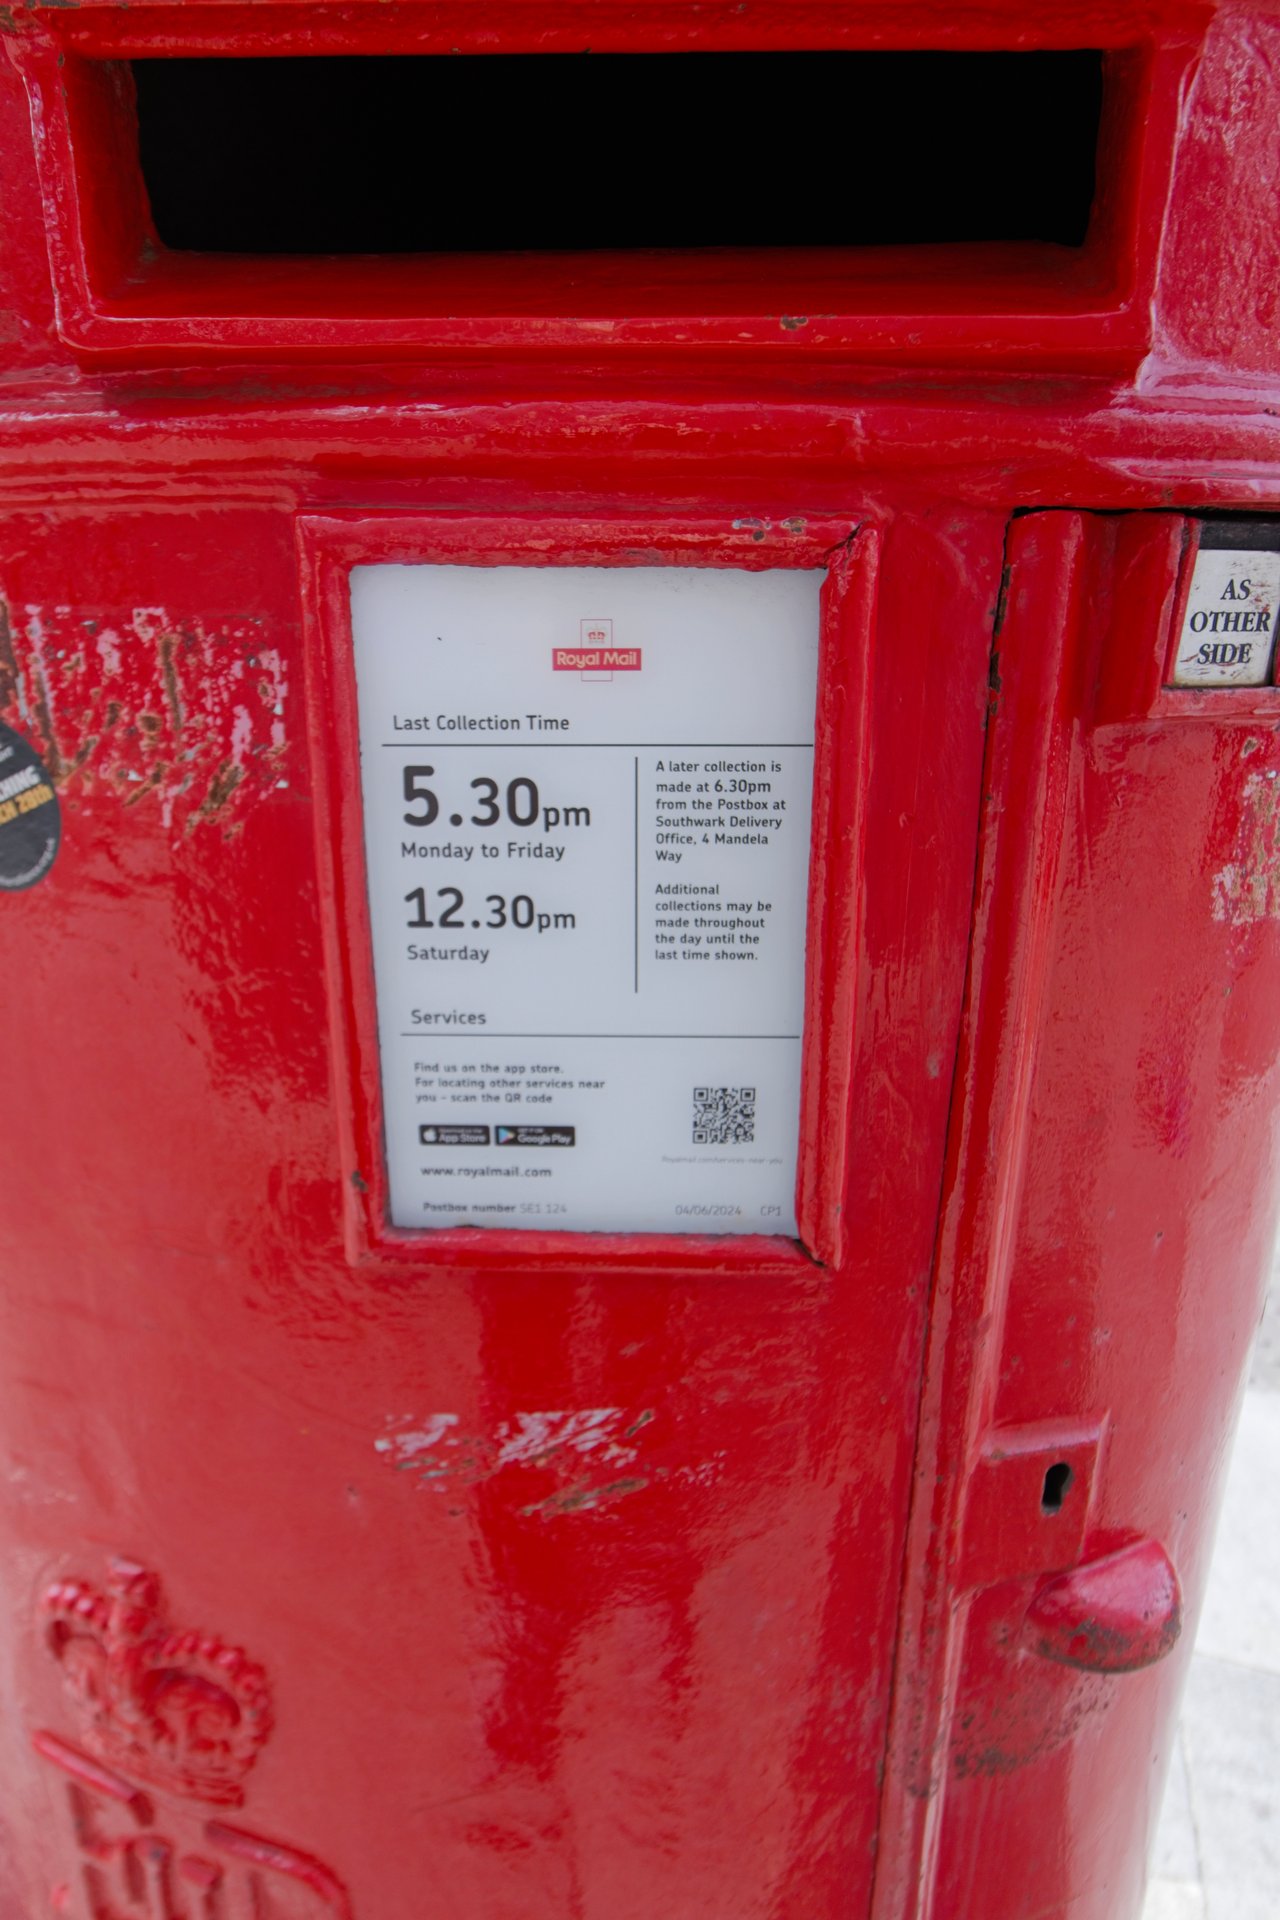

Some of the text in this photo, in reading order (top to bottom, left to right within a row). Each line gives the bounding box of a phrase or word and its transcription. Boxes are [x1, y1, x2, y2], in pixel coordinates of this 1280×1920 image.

[1221, 579, 1251, 600] AS
[1190, 611, 1271, 632] OTHER
[557, 651, 637, 668] Royal Mail
[1197, 643, 1252, 664] SIDE
[394, 715, 569, 730] Last Collection Time
[656, 761, 781, 772] A later collection is
[656, 779, 771, 795] made at 6.30pm
[403, 766, 590, 832] 5.30pm
[656, 799, 786, 810] from the Postbox at
[656, 816, 782, 830] Southwark Delivery
[656, 833, 768, 845] Office, 4 Mandela
[401, 842, 565, 861] Monday to Friday
[656, 850, 682, 863] Way
[656, 884, 719, 895] Additional
[404, 887, 575, 933] 12.30pm
[656, 901, 771, 913] collections may be
[656, 917, 765, 930] made throughout
[655, 933, 759, 946] the day until the
[407, 944, 489, 963] Saturday
[655, 950, 757, 960] last time shown.
[411, 1009, 486, 1024] Services
[414, 1062, 439, 1072] Find
[481, 1064, 499, 1073] the
[504, 1066, 526, 1074] app
[530, 1064, 564, 1074] store.
[415, 1077, 434, 1087] For
[438, 1078, 485, 1089] locating
[490, 1079, 521, 1088] other
[526, 1079, 573, 1088] services
[416, 1094, 436, 1103] you
[481, 1093, 500, 1102] the
[505, 1093, 521, 1103] QR
[526, 1094, 552, 1103] code
[439, 1134, 486, 1143] App Store
[517, 1134, 571, 1145] Google Play
[421, 1166, 551, 1178] www.royalmail.com
[423, 1202, 567, 1214] Postbox number SE1 124
[675, 1204, 742, 1216] 04/06/2024
